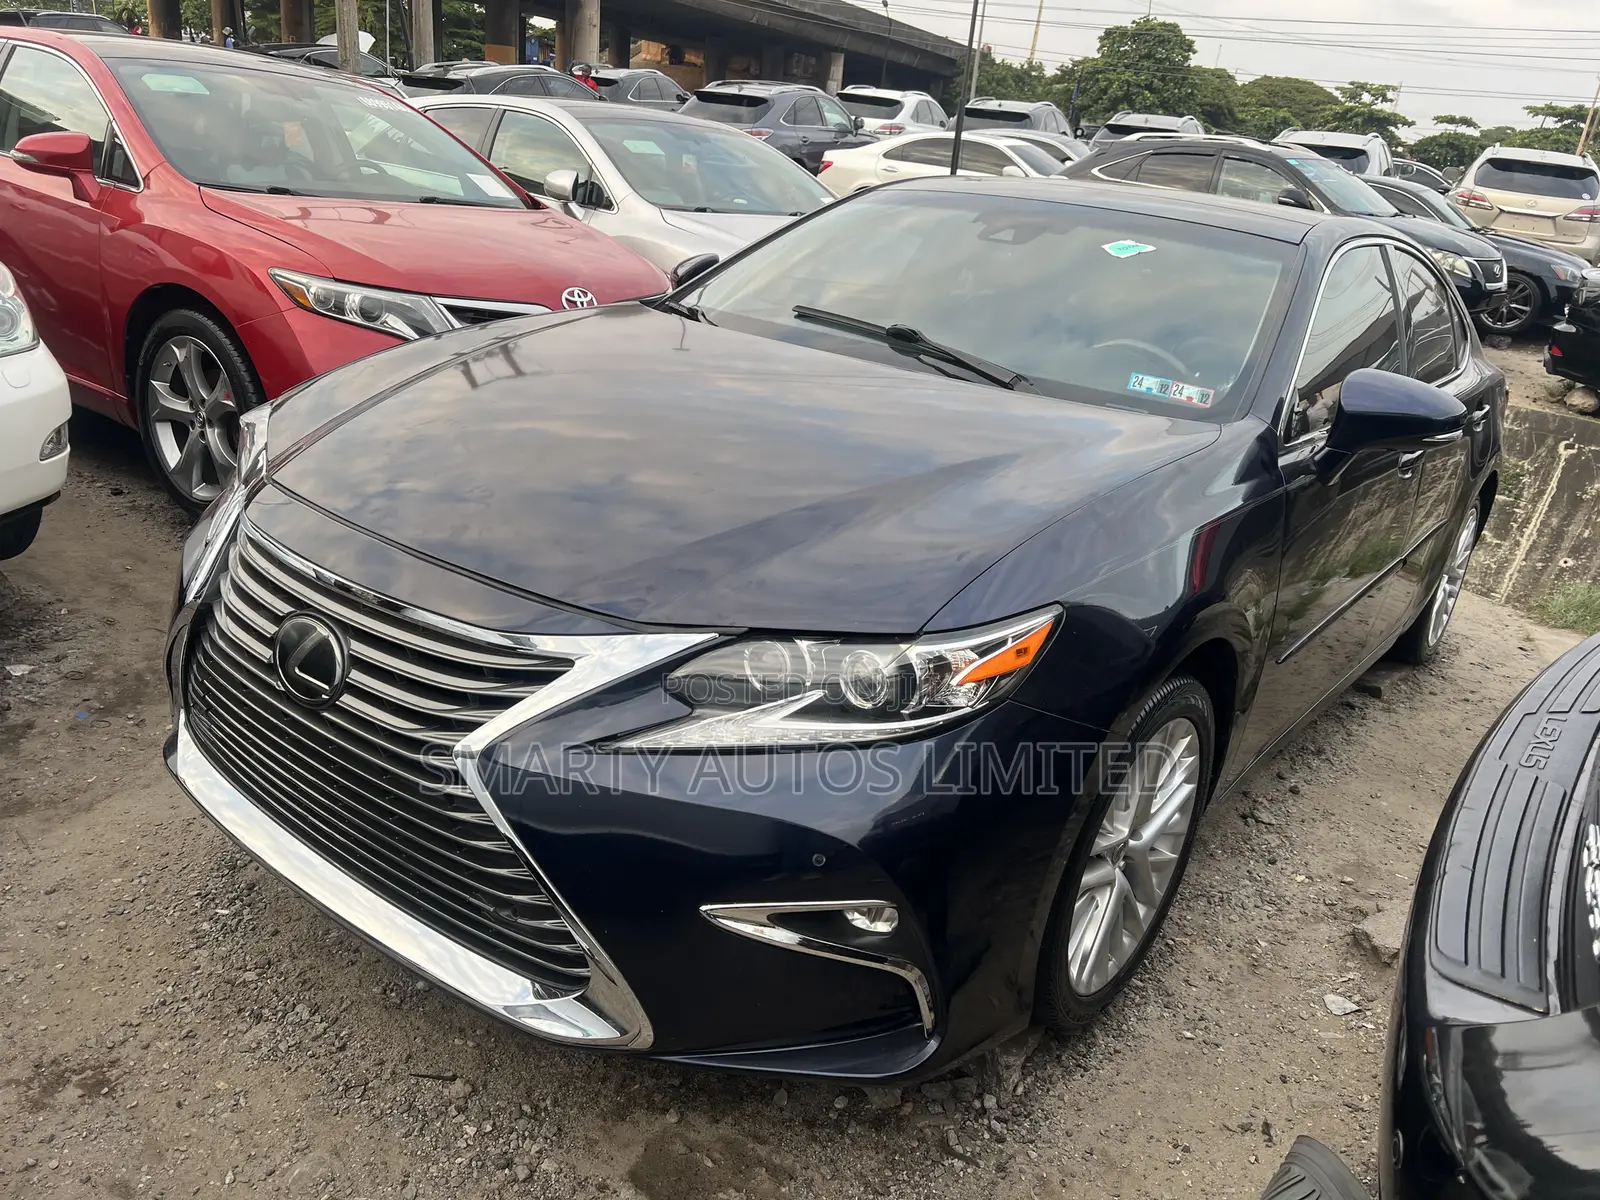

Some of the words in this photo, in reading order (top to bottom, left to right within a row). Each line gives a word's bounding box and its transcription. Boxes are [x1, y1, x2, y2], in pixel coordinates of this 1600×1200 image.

[1132, 375, 1145, 388] 24
[1159, 383, 1170, 395] 12
[1172, 383, 1185, 397] 24
[1200, 393, 1211, 405] 12
[1518, 716, 1568, 770] LEXUS
